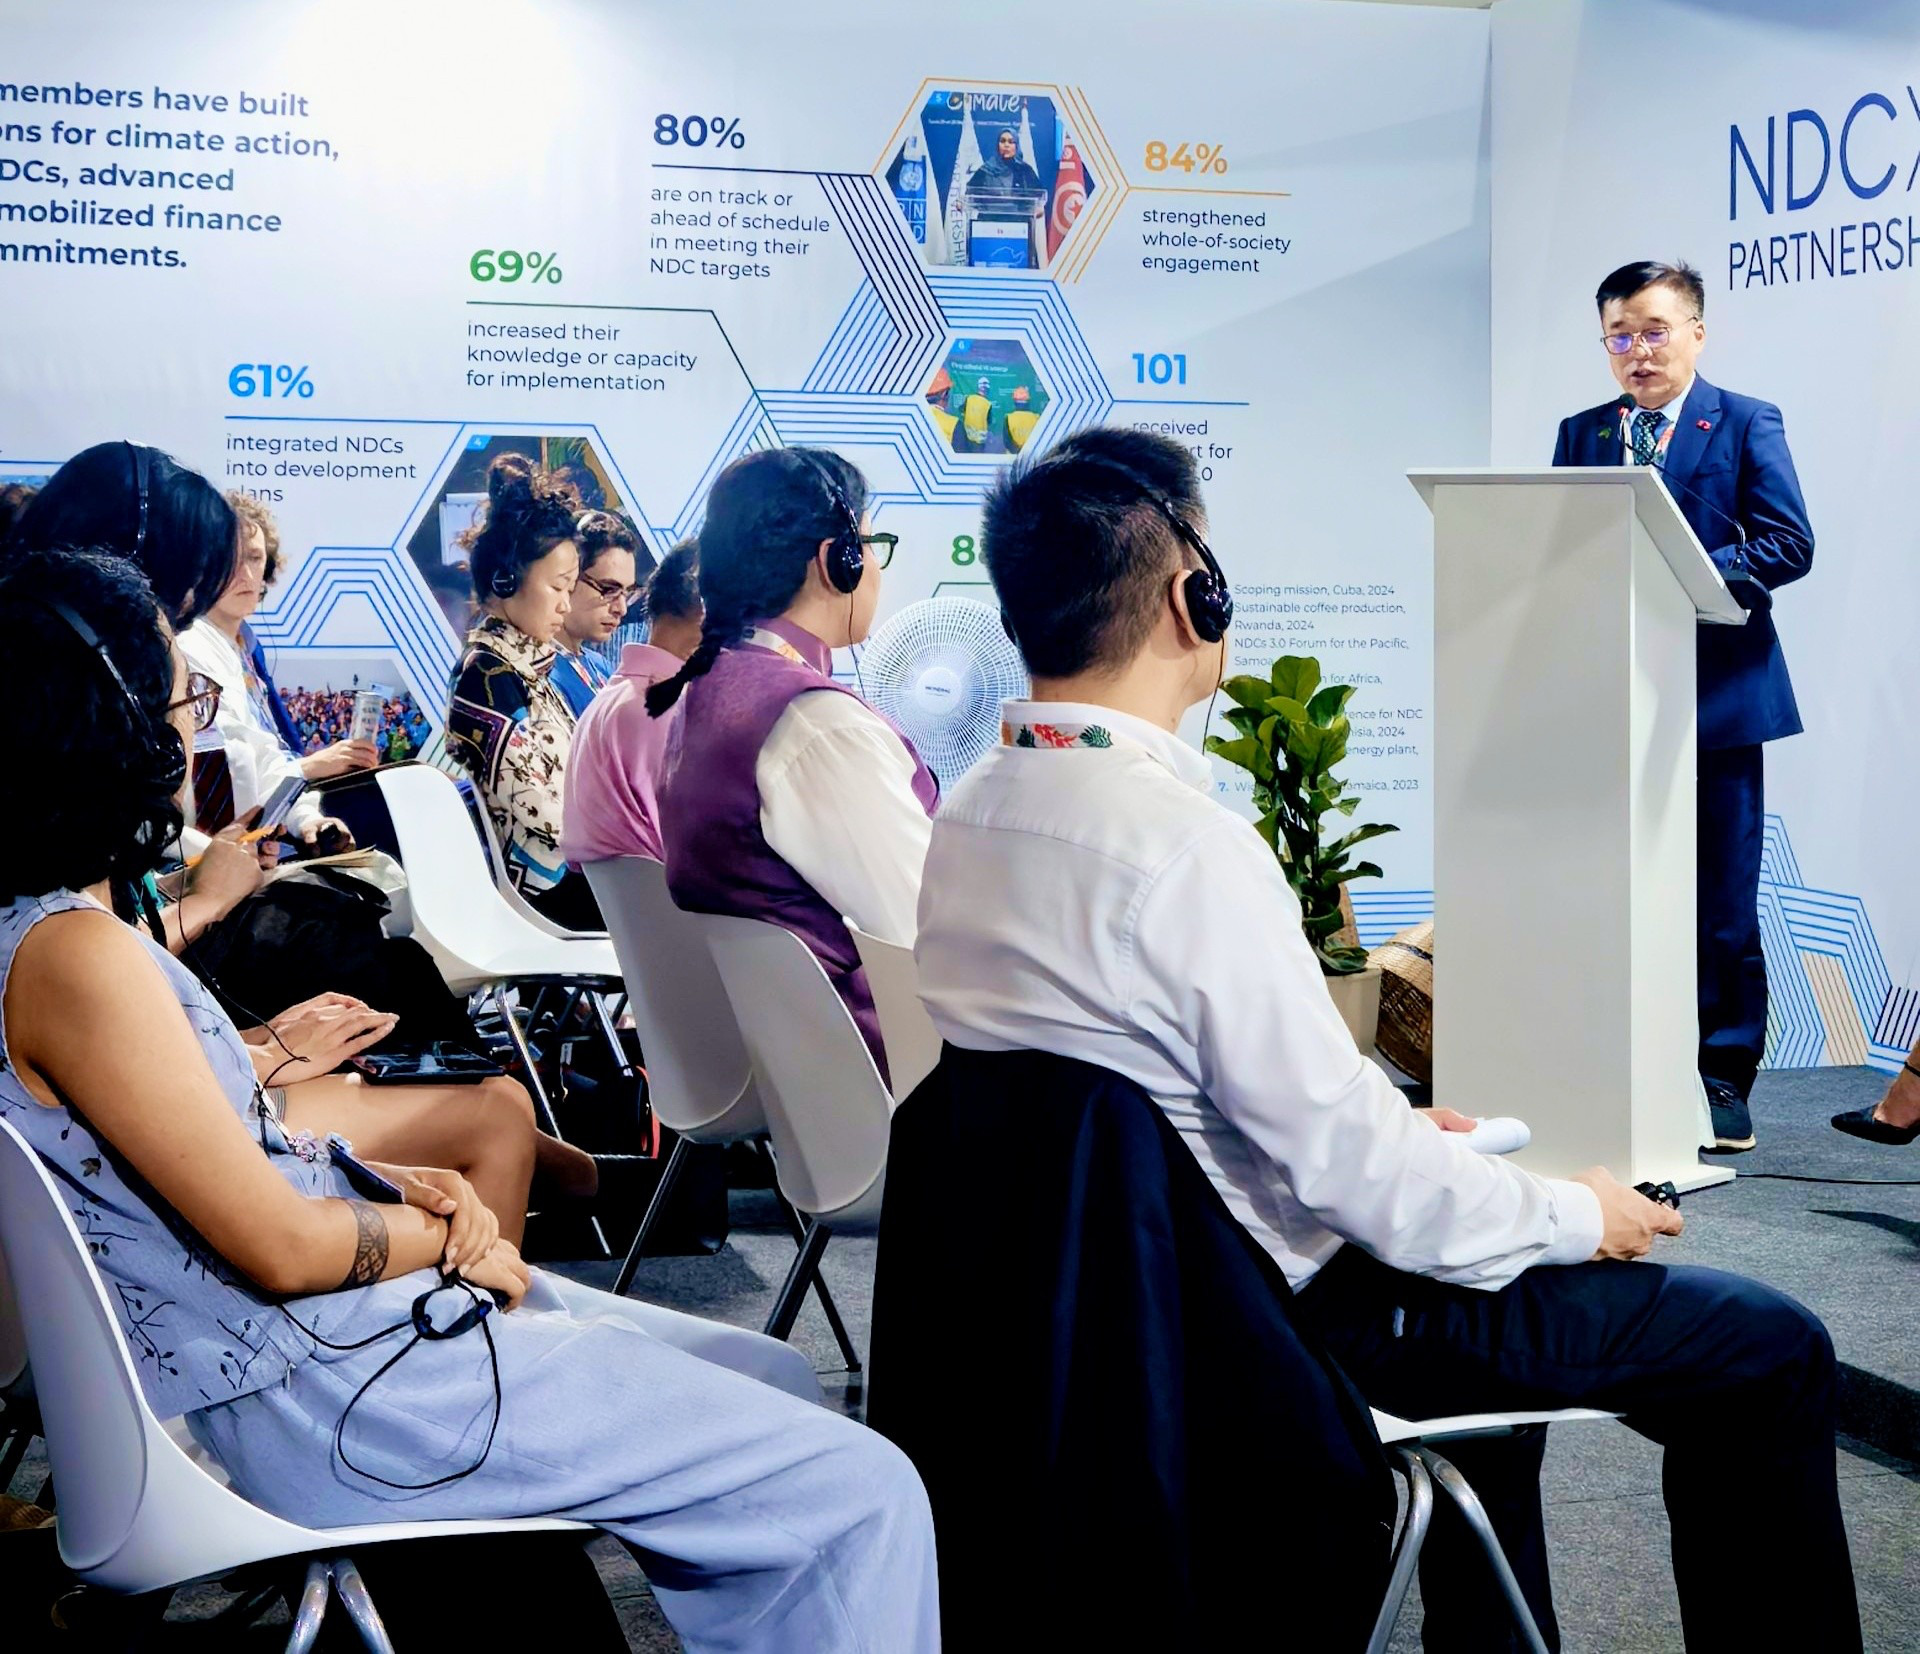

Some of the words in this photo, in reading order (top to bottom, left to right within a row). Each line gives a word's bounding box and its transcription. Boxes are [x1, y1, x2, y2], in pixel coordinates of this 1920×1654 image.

[153, 86, 230, 114] have
[239, 91, 310, 118] built
[51, 120, 97, 146] for
[106, 123, 226, 151] climate
[234, 131, 340, 162] action,
[652, 113, 746, 150] 80%
[1143, 140, 1229, 175] 84%
[78, 162, 235, 192] advanced
[651, 188, 683, 202] are
[687, 189, 713, 204] on
[718, 188, 768, 206] track
[773, 193, 794, 207] or
[0, 199, 155, 228] mobilized
[164, 204, 283, 232] finance
[650, 209, 711, 227] ahead
[717, 211, 738, 228] of
[741, 214, 831, 232] schedule
[1142, 209, 1267, 228] strengthened
[650, 232, 667, 249] in
[674, 235, 758, 257] meeting
[764, 238, 810, 255] their
[1142, 231, 1292, 254] whole-of-society
[469, 249, 564, 285] 69%
[650, 258, 696, 275] NDC
[701, 260, 771, 280] targets
[1142, 256, 1261, 274] engagement
[467, 319, 567, 340] increased
[573, 322, 621, 342] their
[467, 345, 583, 368] knowledge
[587, 351, 609, 365] or
[613, 351, 699, 372] capacity
[1131, 352, 1187, 385] 101
[228, 363, 315, 399] 61%
[466, 370, 495, 389] for
[500, 371, 667, 393] implementation
[1132, 419, 1209, 435] received
[225, 433, 339, 456] integrated
[345, 436, 405, 454] NDCs
[1208, 442, 1233, 459] for
[225, 458, 269, 477] into
[273, 459, 417, 483] development
[1234, 584, 1282, 597] Scoping
[1283, 585, 1331, 597] mission,
[1332, 584, 1366, 597] Cuba,
[1367, 584, 1395, 596] 2024
[1234, 601, 1301, 614] Sustainable
[1303, 603, 1339, 614] coffee
[1340, 604, 1407, 615] production,
[1234, 620, 1285, 632] Rwanda,
[1286, 620, 1315, 631] 2024
[1234, 637, 1267, 649] NDCs
[1269, 637, 1287, 649] 3.0
[1288, 637, 1328, 649] Forum
[1329, 637, 1346, 649] for
[1347, 637, 1367, 649] the
[1369, 637, 1410, 650] Pacific,
[1329, 672, 1346, 684] for
[1347, 672, 1383, 685] Africa,
[1378, 708, 1394, 720] for
[1397, 708, 1424, 720] NDC
[1376, 726, 1405, 738] 2024
[1387, 744, 1420, 758] plant,
[1392, 779, 1419, 791] 2023
